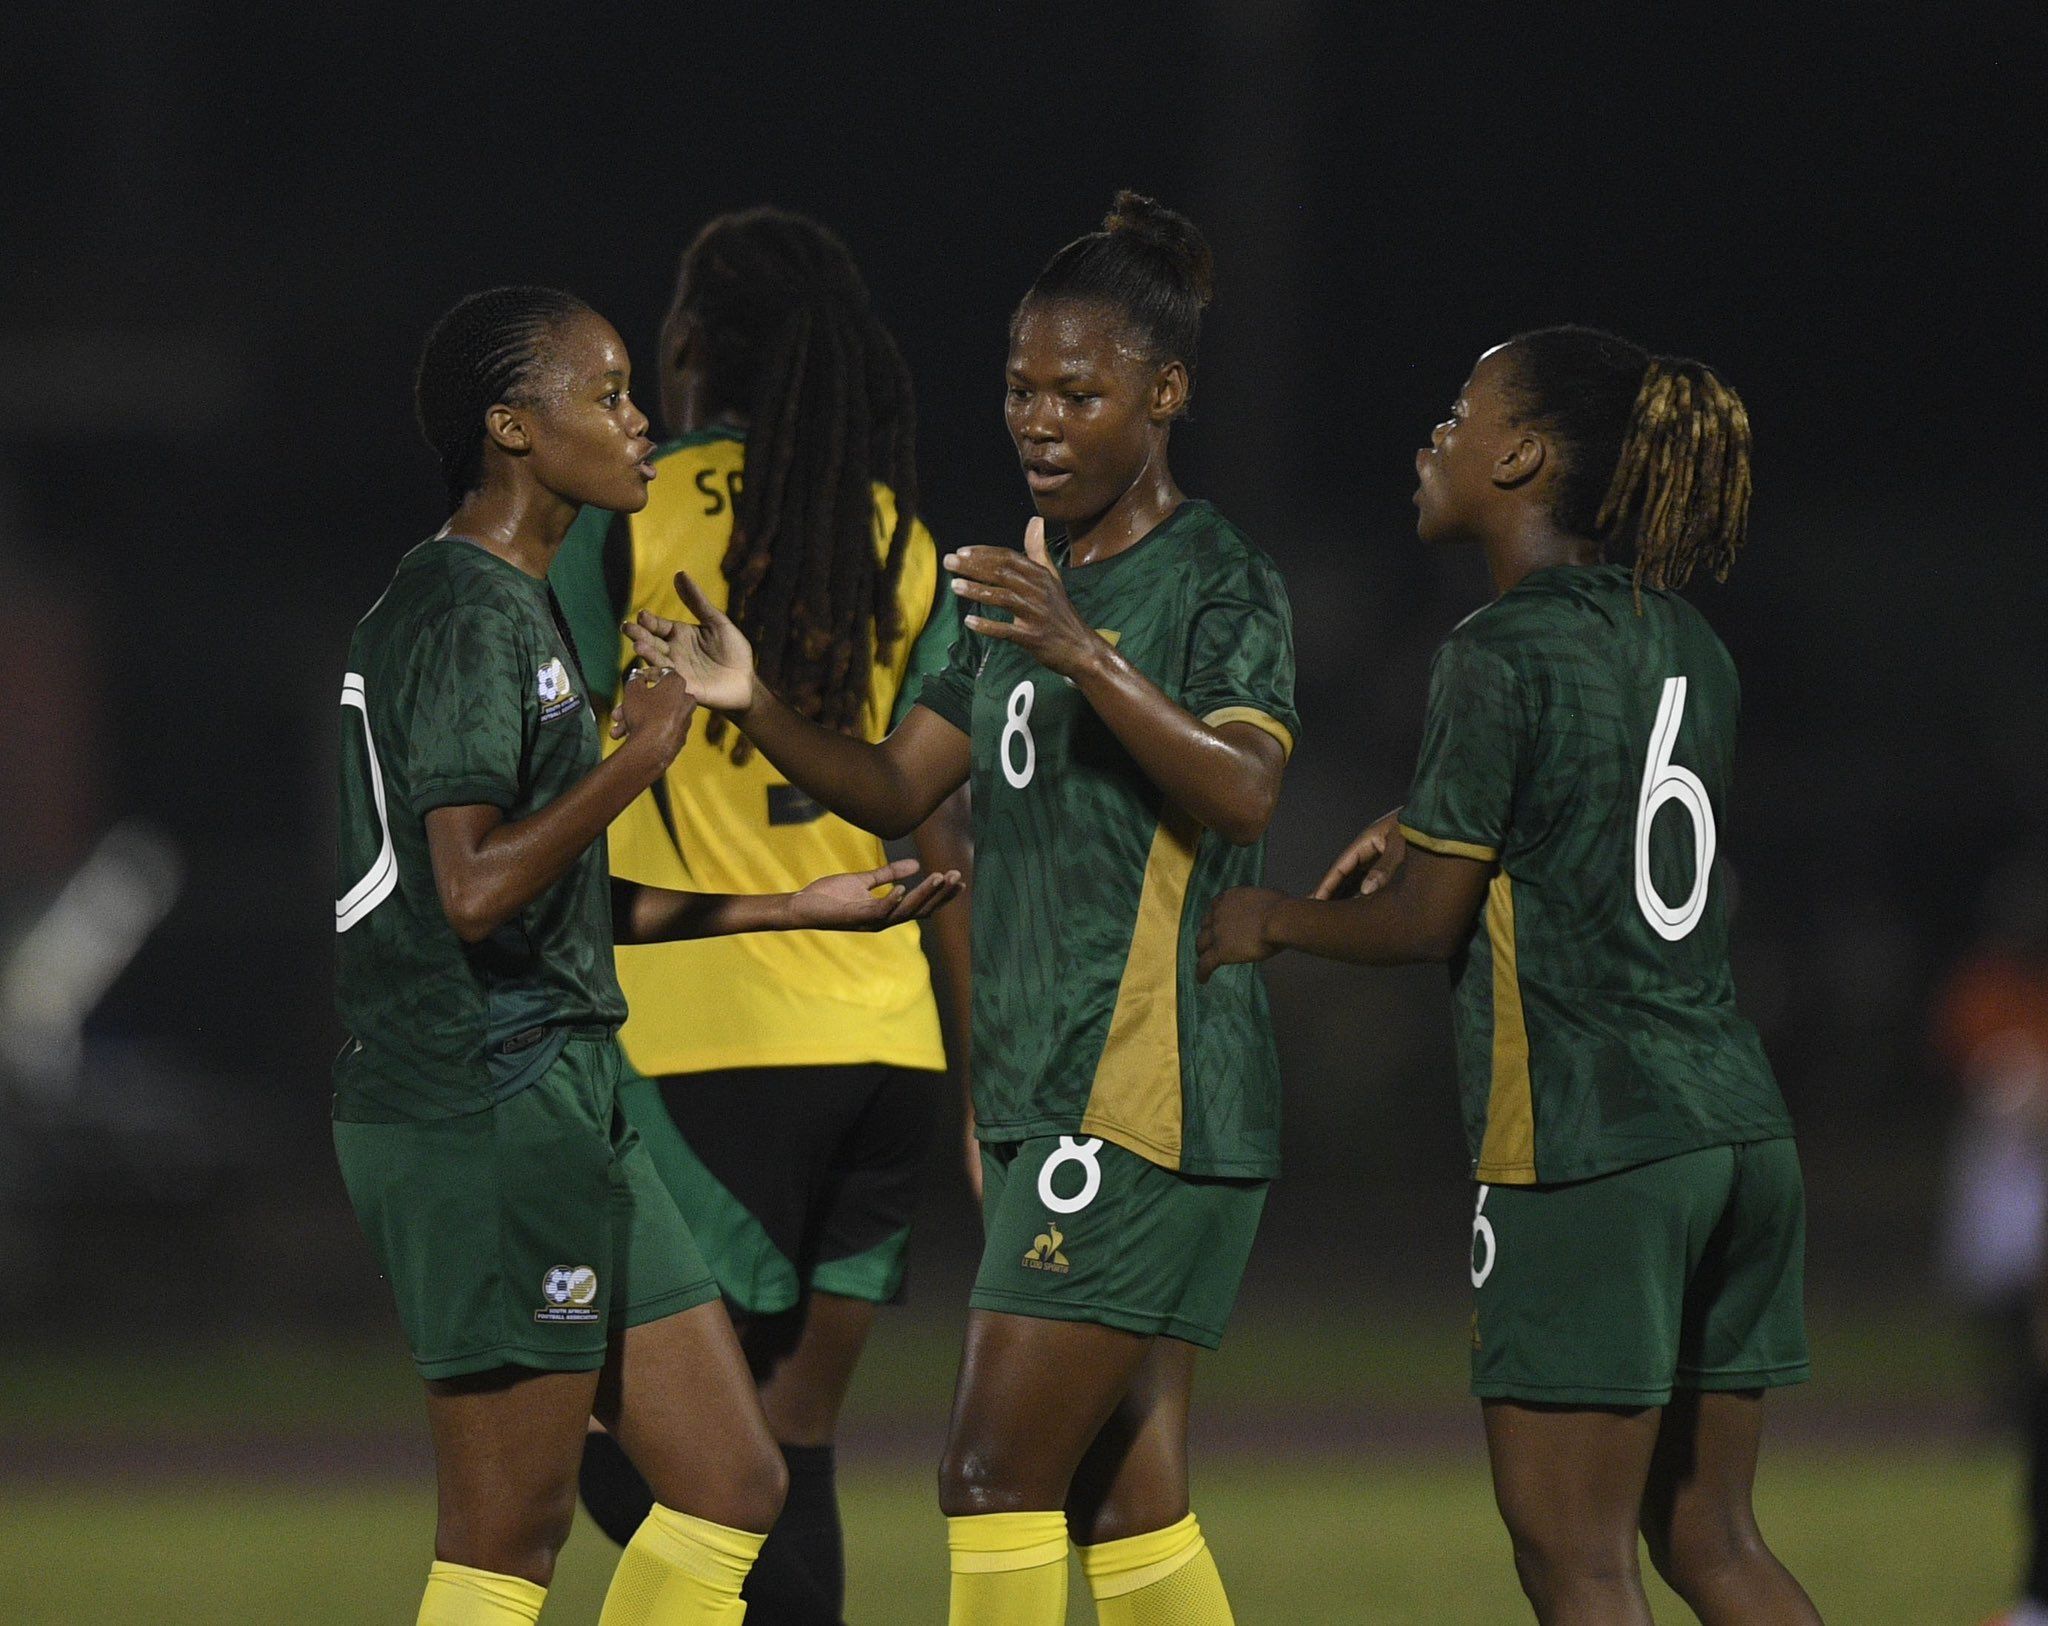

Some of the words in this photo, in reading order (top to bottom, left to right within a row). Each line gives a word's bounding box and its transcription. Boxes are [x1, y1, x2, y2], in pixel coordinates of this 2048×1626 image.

[1001, 680, 1036, 789] 8
[1635, 676, 1717, 941] 6
[1471, 1184, 1496, 1289] 6
